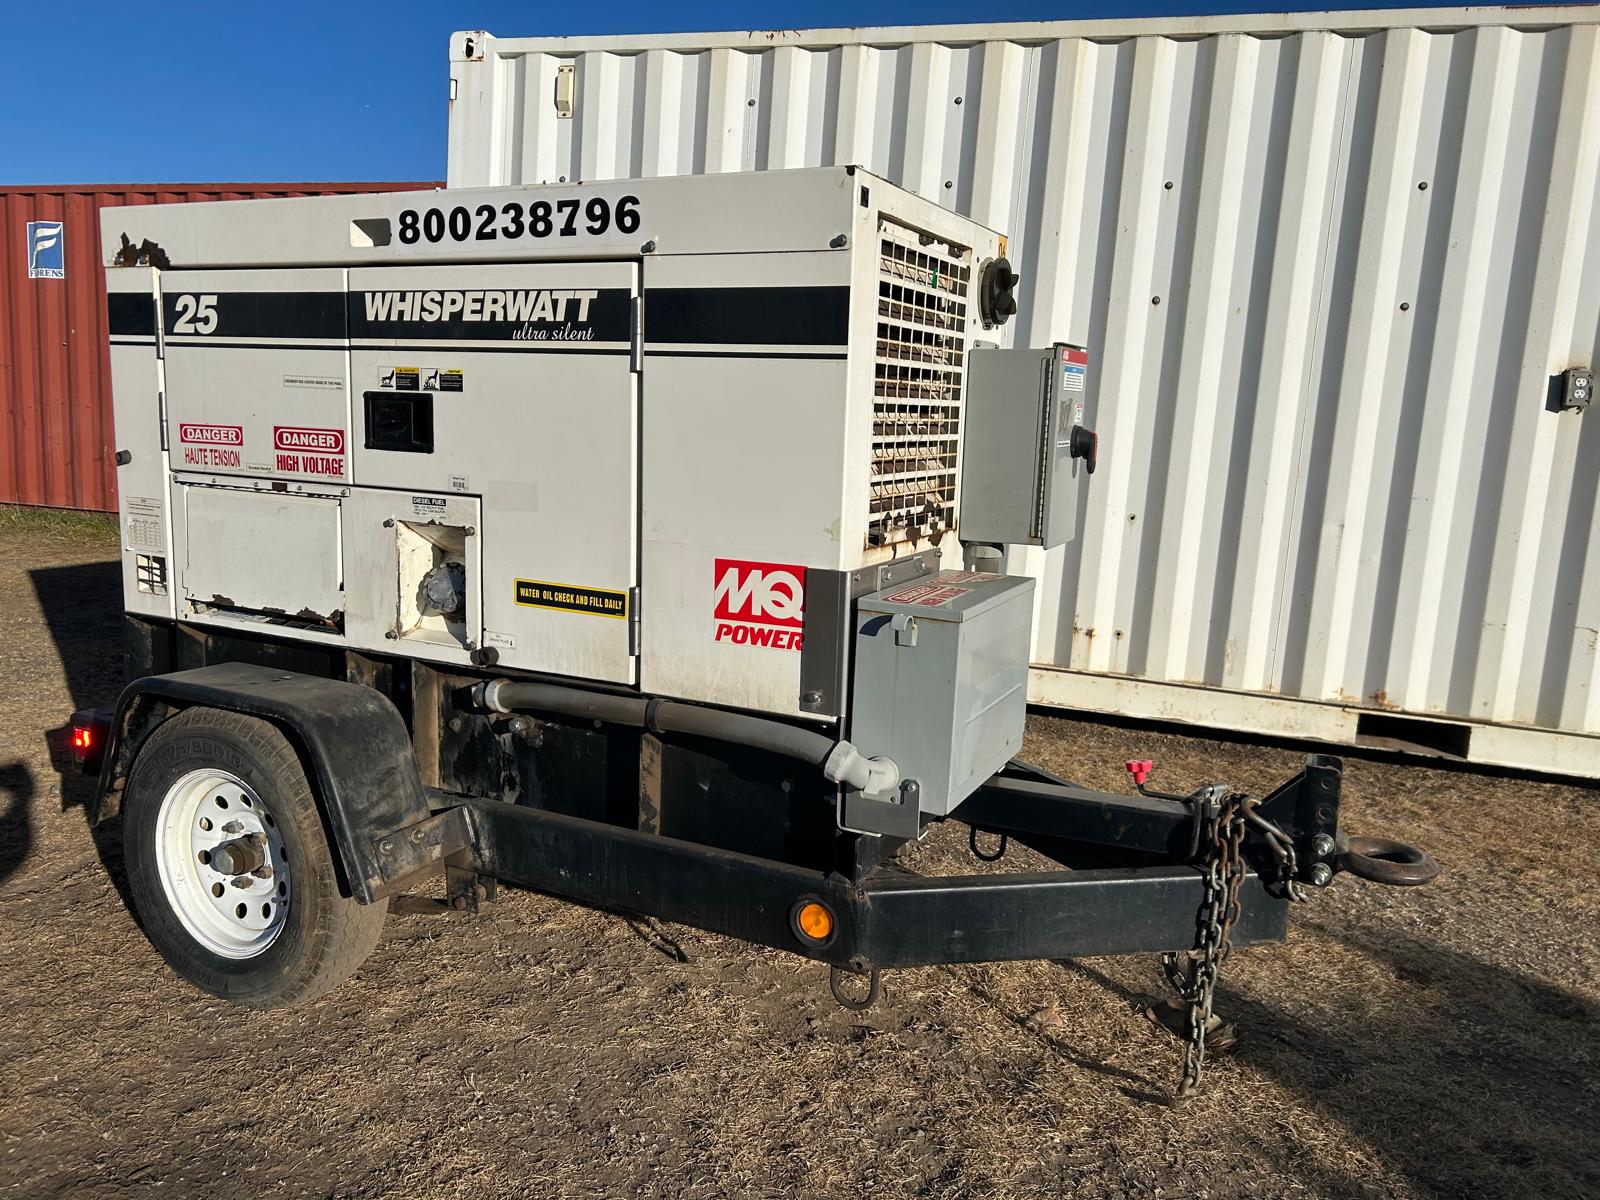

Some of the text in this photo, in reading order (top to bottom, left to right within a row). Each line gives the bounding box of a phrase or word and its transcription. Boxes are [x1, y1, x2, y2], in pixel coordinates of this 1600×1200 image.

[399, 195, 641, 245] 800238796
[30, 268, 63, 278] FORENS
[173, 294, 219, 335] 25
[364, 290, 598, 323] WHISPERWATT
[512, 322, 595, 342] ultra silent
[186, 427, 237, 442] DANGER
[282, 431, 335, 448] DANGER
[184, 447, 241, 467] HAUTE TENSION
[276, 454, 344, 476] HIGH VOLTAGE
[413, 497, 446, 506] DIESEL FUEL
[519, 587, 623, 610] WATER OIL CHECK AND FILL DAILY
[714, 567, 804, 622] MQ
[715, 623, 805, 651] POWER
